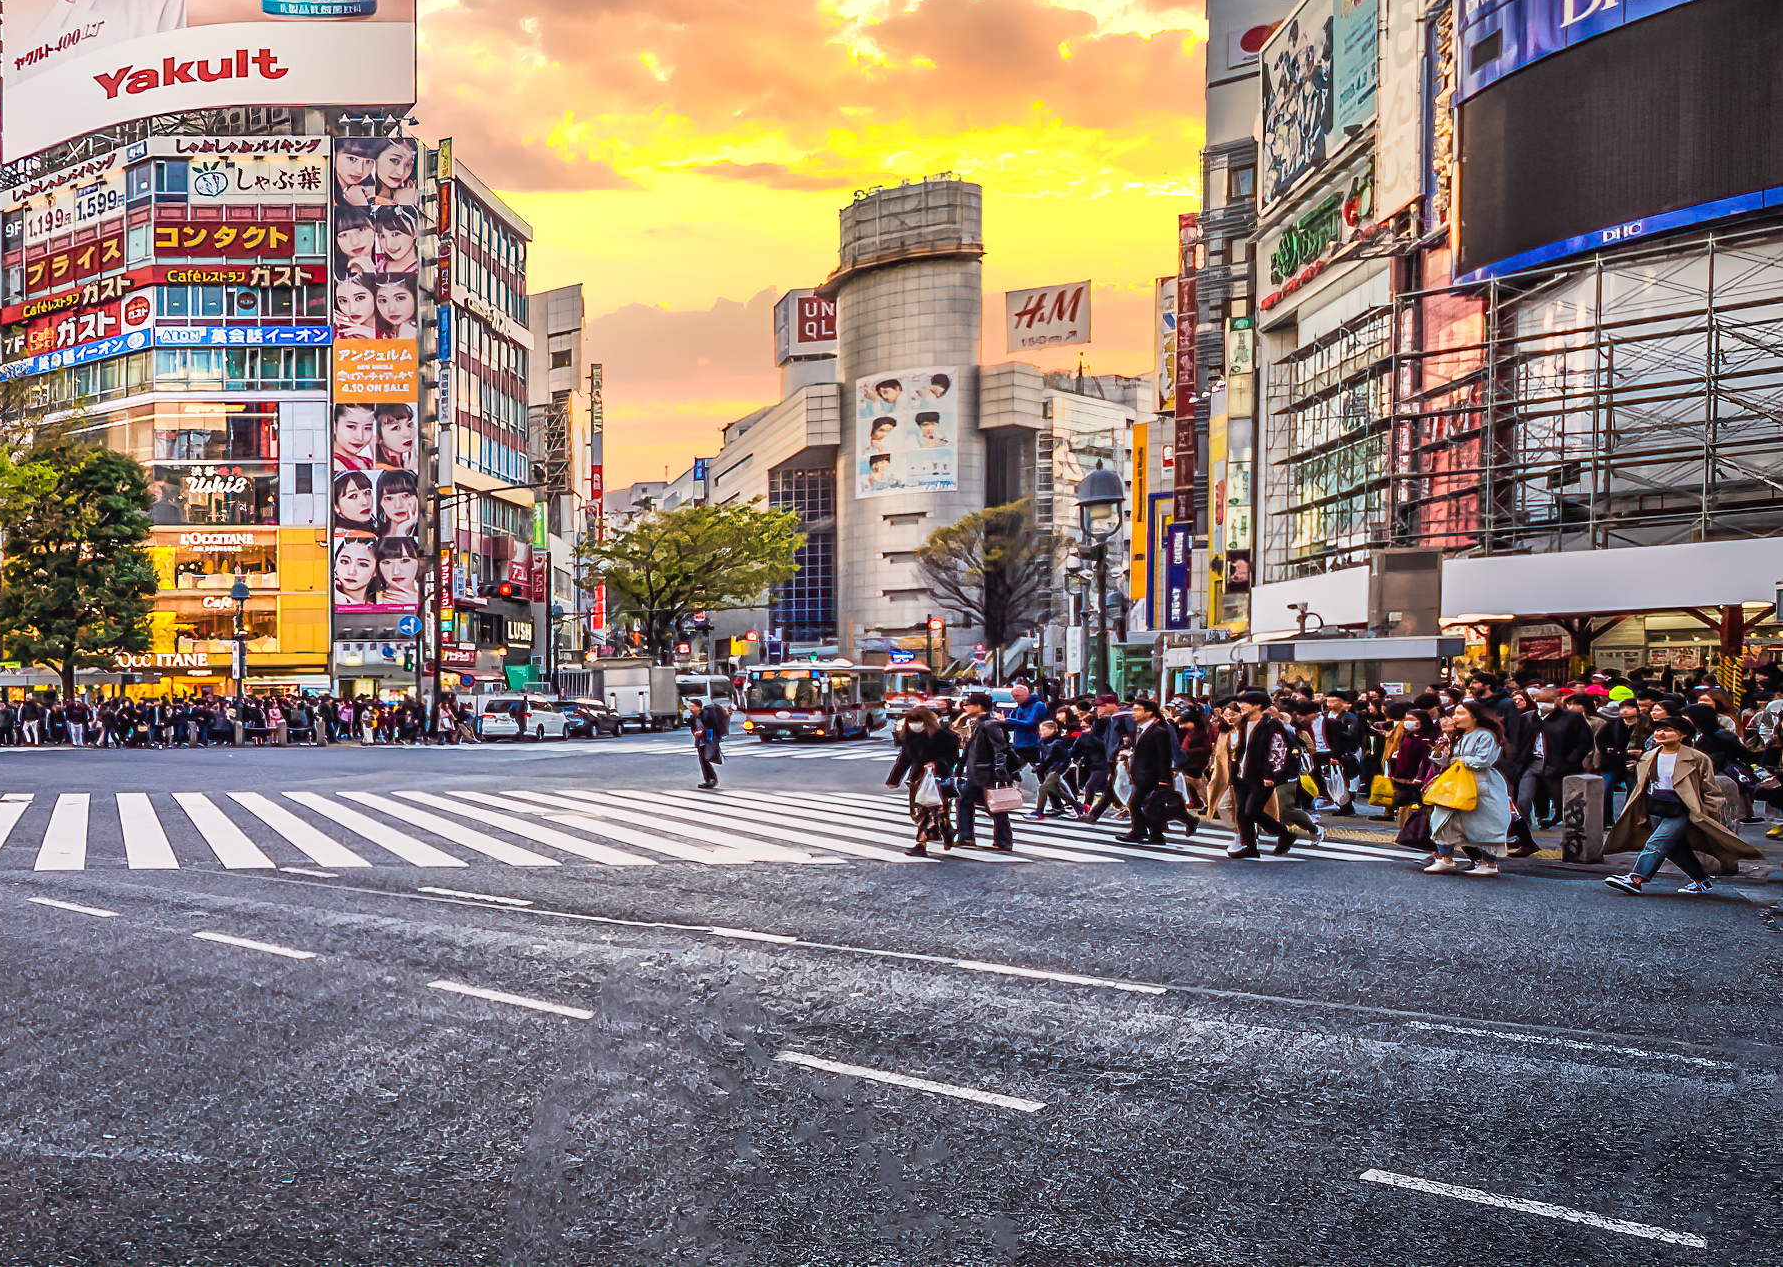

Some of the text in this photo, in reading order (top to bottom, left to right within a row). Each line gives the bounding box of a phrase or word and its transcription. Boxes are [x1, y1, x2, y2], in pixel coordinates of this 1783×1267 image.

[93, 48, 290, 100] Yakult
[236, 166, 322, 191] しゃぶ葉
[5, 219, 23, 237] 9F
[155, 226, 289, 249] コンタクト
[1602, 220, 1642, 242] DHC
[27, 236, 122, 286] プライス
[250, 266, 314, 287] ガスト
[82, 275, 131, 305] ガスト
[805, 302, 836, 317] UN
[1014, 287, 1084, 329] H&M
[56, 310, 116, 348] ガスト
[210, 328, 330, 344] 英会話イーオン
[805, 320, 835, 339] QL
[4, 333, 25, 354] 7F
[338, 348, 413, 362] アンジュルム
[341, 383, 409, 393] 4.10 ON SALE
[508, 621, 532, 641] LUSH
